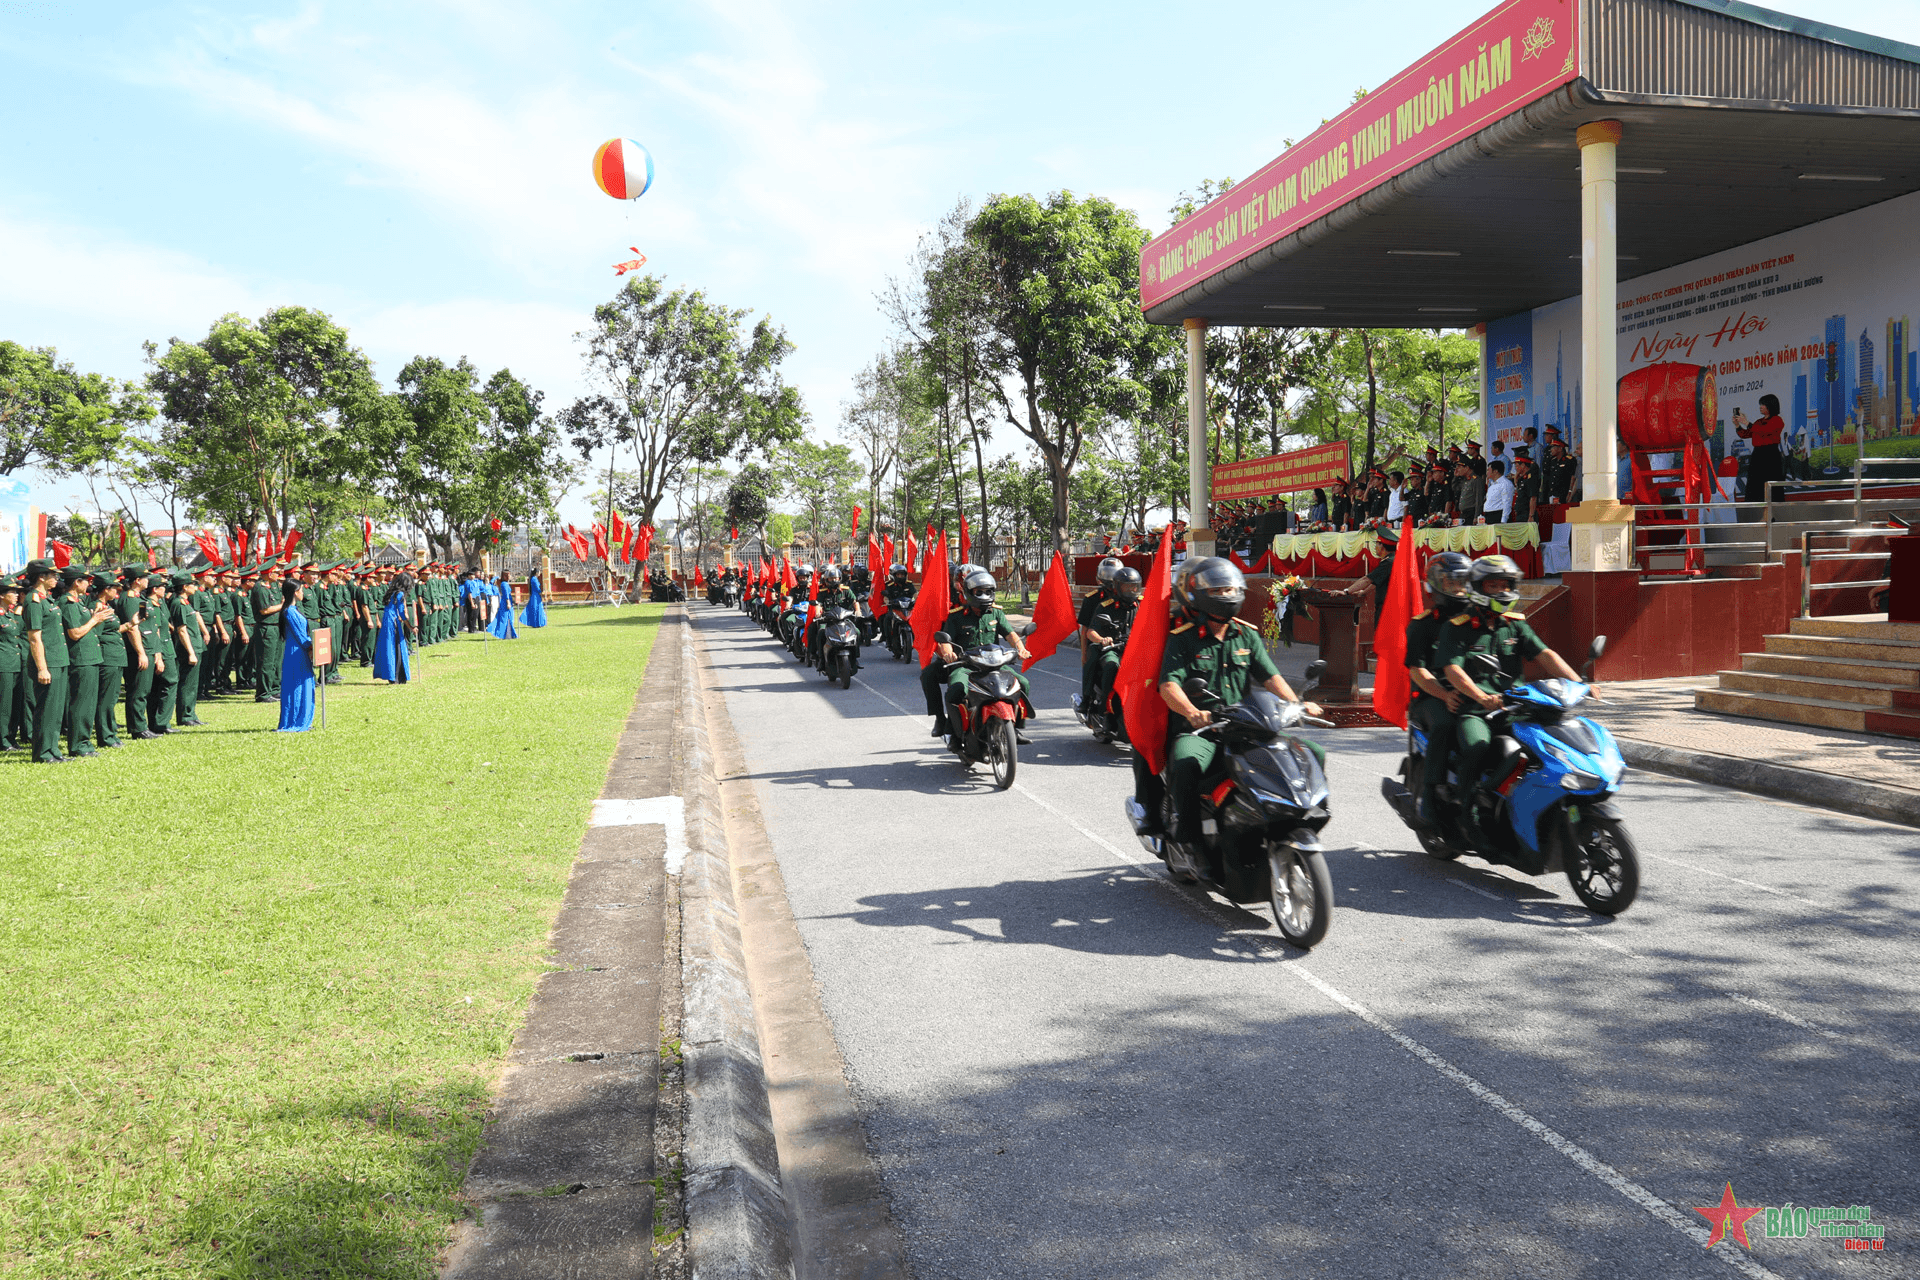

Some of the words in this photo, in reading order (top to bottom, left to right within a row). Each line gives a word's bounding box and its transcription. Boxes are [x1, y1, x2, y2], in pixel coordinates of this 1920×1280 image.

[1159, 243, 1184, 283] ĐẢNG
[1186, 227, 1213, 270] CỘNG
[1215, 206, 1238, 251] SẢN
[1240, 192, 1265, 238] VIỆT
[1267, 173, 1297, 222] NAM
[1301, 141, 1348, 204] QUANG
[1352, 112, 1391, 171] VINH
[1396, 73, 1453, 145] MUÔN
[1460, 36, 1511, 109] NĂM
[1695, 275, 1712, 291] QUÂN
[1726, 266, 1744, 280] NHÂN
[1745, 262, 1760, 275] DÂN
[1761, 258, 1777, 271] VIỆT
[1778, 253, 1795, 266] NAM
[1629, 330, 1700, 363] Ngày
[1704, 311, 1771, 348] Hội
[1719, 360, 1741, 376] GIAO
[1743, 351, 1774, 372] THÔNG
[1777, 344, 1798, 365] NĂM
[1800, 342, 1825, 360] 2024
[1719, 386, 1728, 396] 10
[1729, 383, 1745, 395] năm
[1746, 380, 1764, 392] 2024
